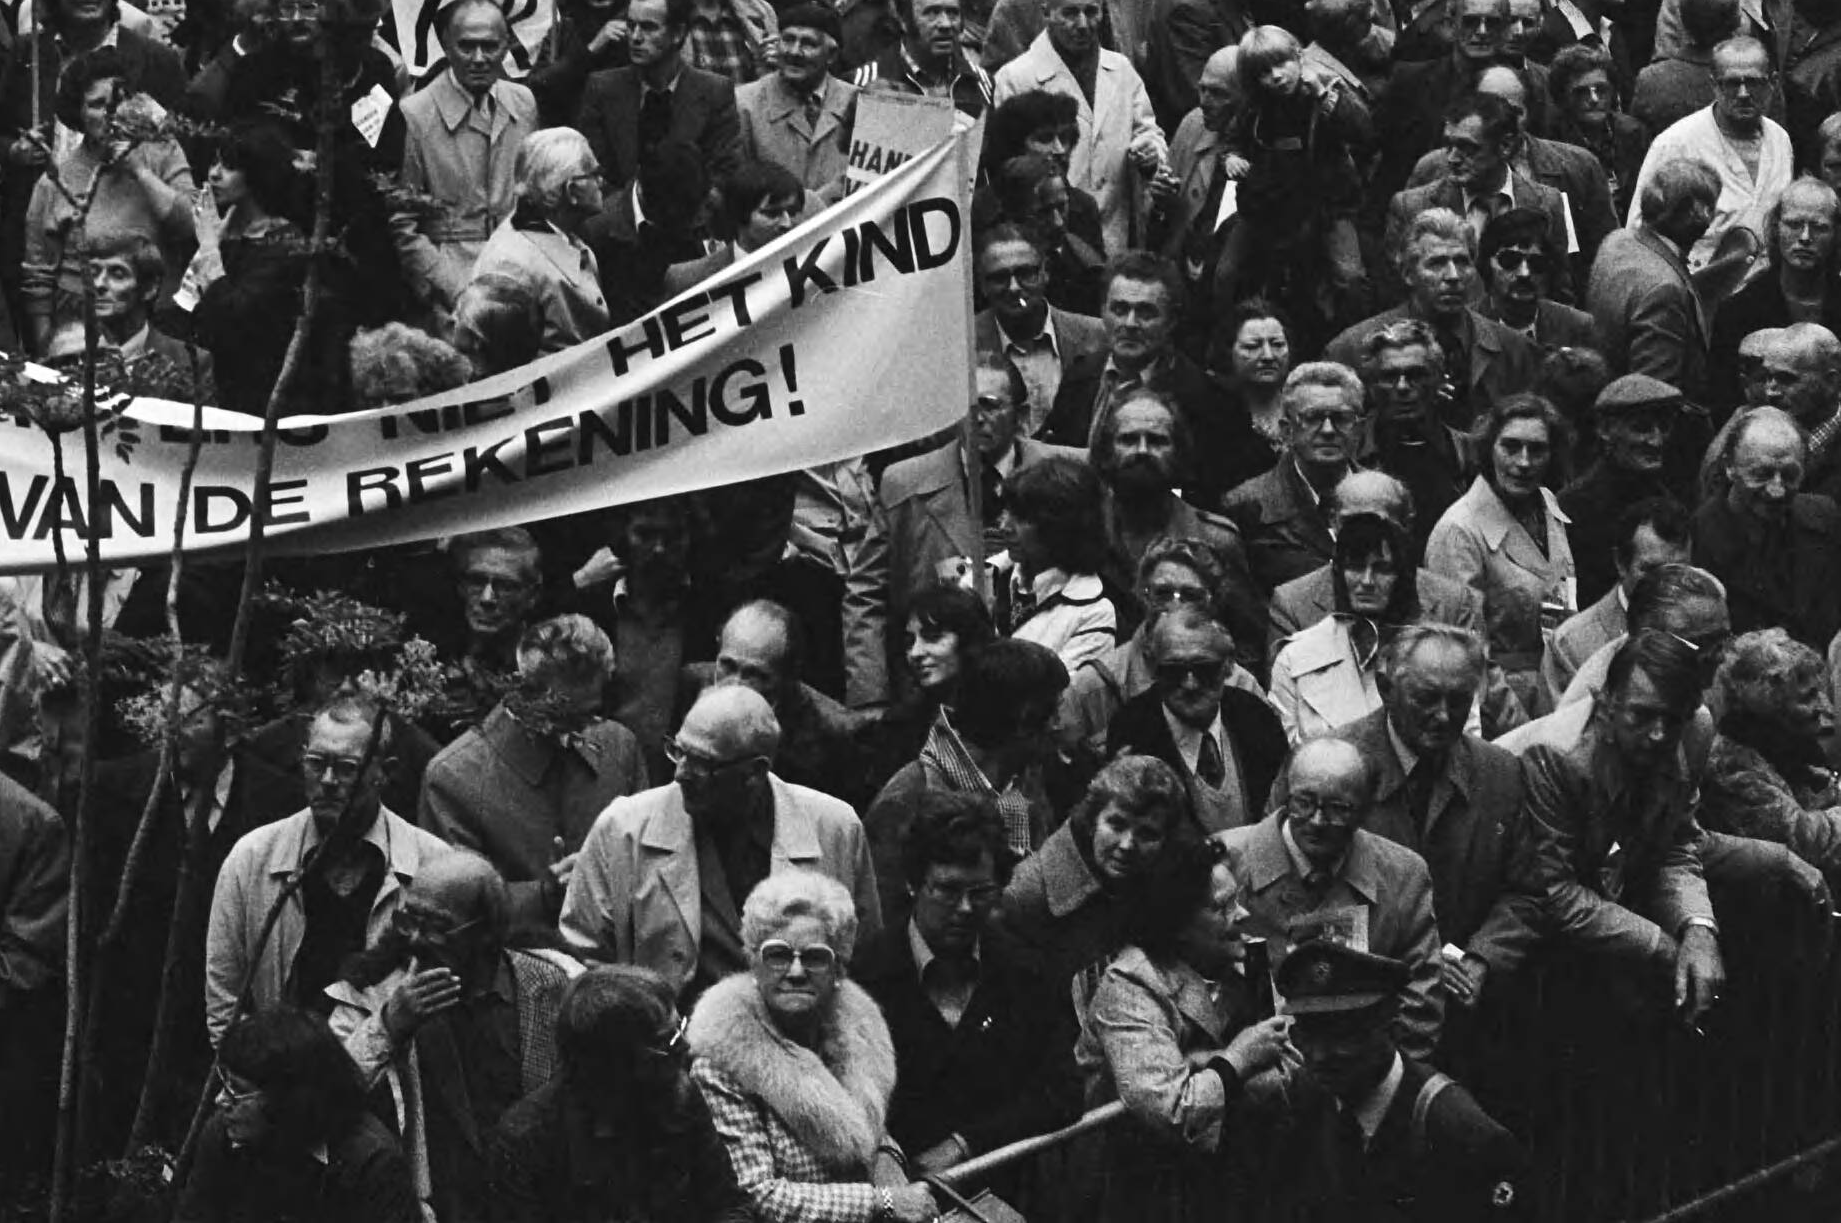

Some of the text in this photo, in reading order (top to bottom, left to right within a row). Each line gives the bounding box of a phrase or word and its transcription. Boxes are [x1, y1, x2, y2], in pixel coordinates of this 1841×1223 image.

[606, 272, 762, 377] HET
[782, 196, 962, 310] KIND
[193, 479, 311, 534] DE
[346, 341, 807, 518] REKENING!
